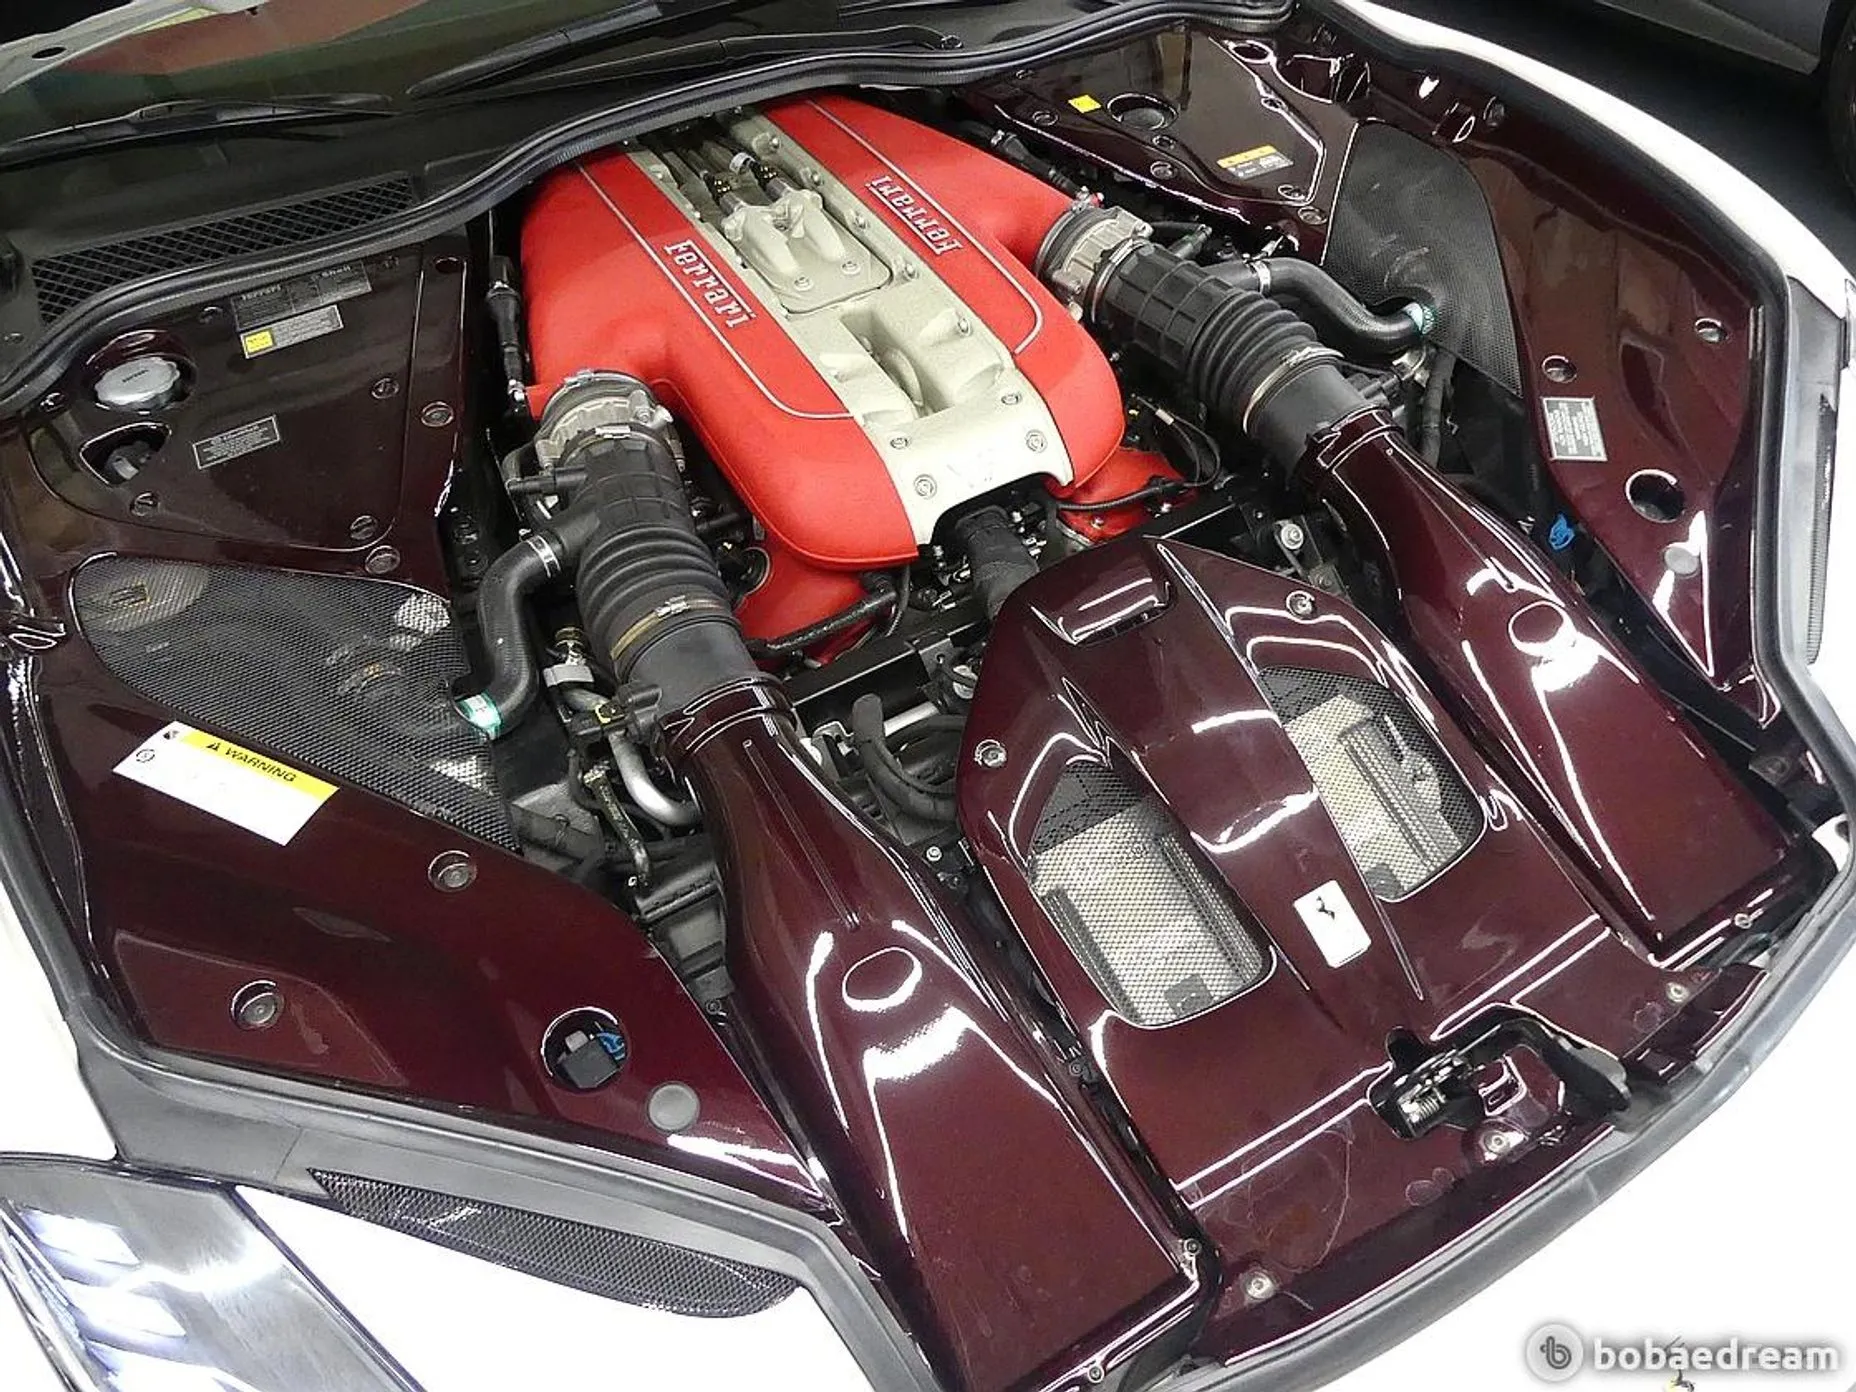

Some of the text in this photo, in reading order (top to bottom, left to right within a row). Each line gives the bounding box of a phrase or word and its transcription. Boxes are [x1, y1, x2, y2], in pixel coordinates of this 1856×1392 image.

[865, 176, 963, 255] Ferrari
[664, 240, 756, 327] Ferrari
[225, 748, 297, 782] WARNING
